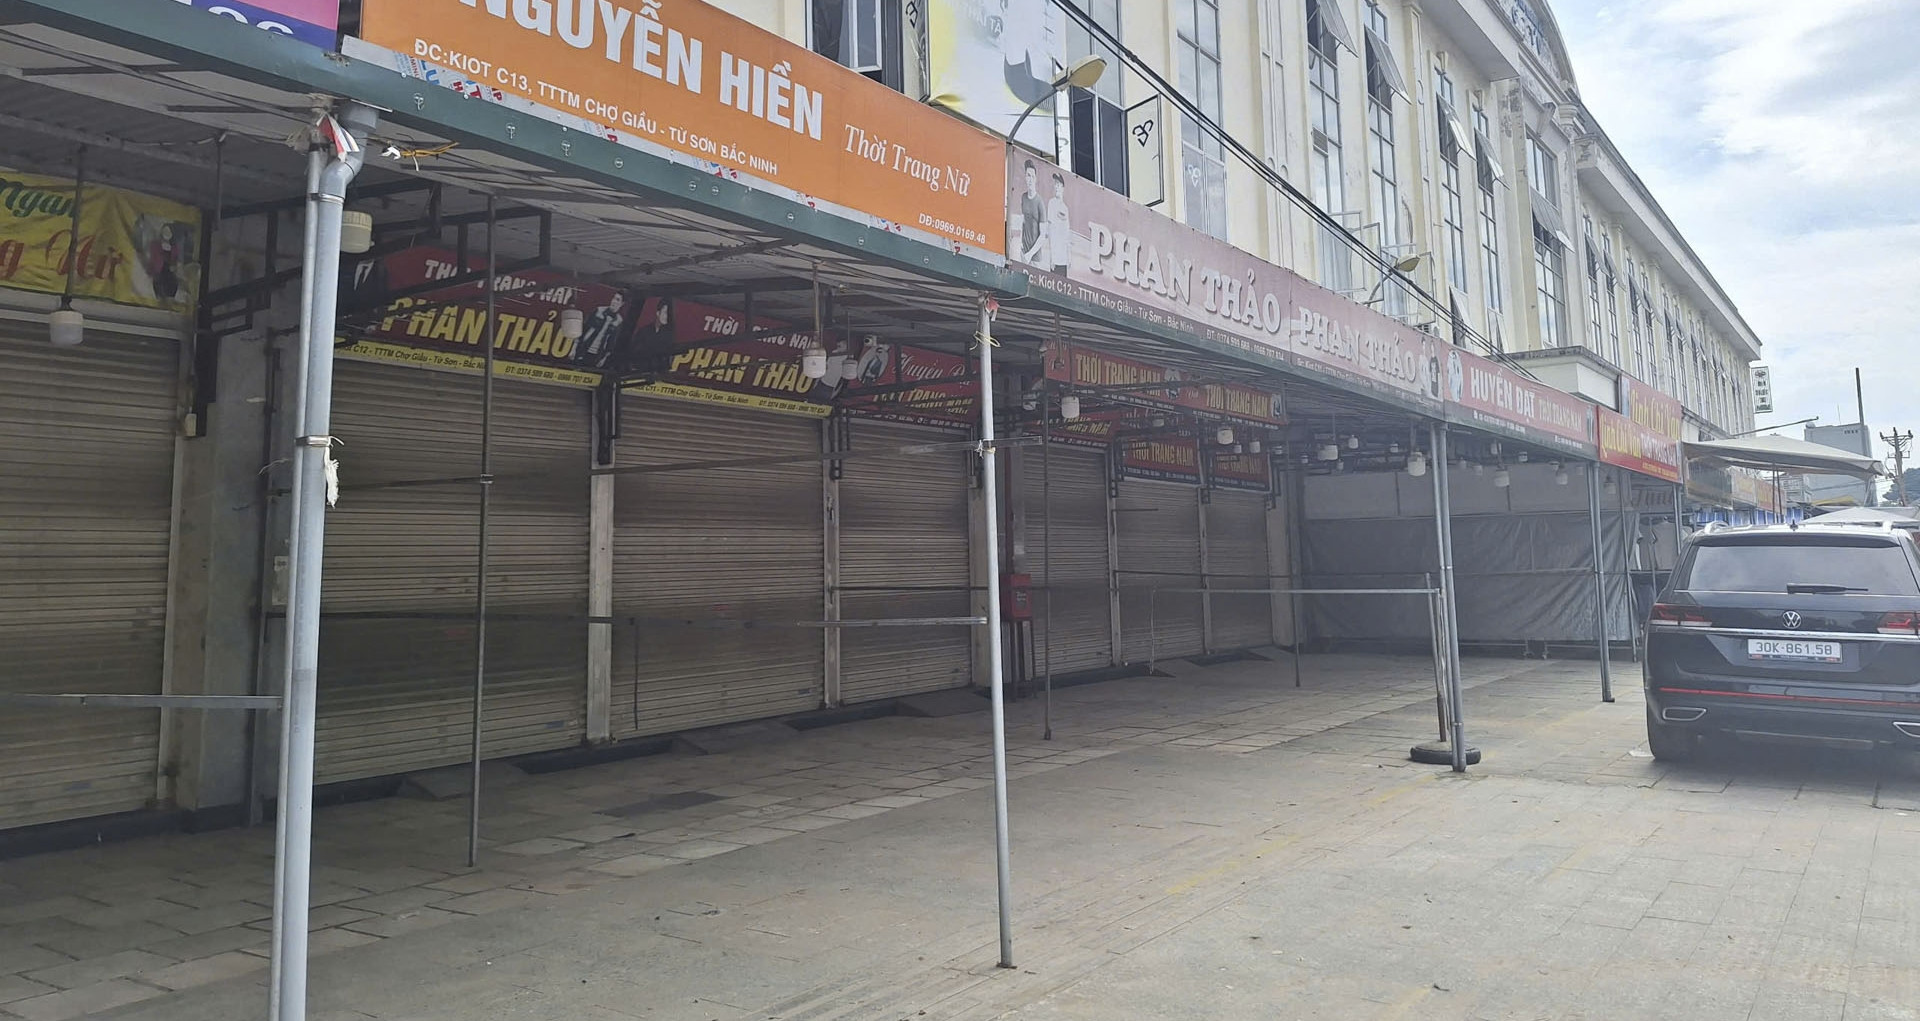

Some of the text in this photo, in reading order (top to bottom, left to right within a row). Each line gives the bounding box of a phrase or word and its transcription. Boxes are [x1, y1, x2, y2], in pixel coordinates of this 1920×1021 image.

[496, 67, 532, 95] C13,
[537, 81, 580, 108] TTTM
[584, 98, 619, 123] CHỢ
[622, 111, 657, 134] GIẦU
[668, 126, 688, 144] TỪ
[689, 134, 717, 155] SƠN
[720, 142, 746, 165] BẮC
[749, 155, 778, 176] NINH
[719, 51, 823, 141] HIỀN
[844, 123, 971, 197] Thời Trang Nữ
[1038, 274, 1055, 290] Kiot
[1057, 280, 1072, 296] C12
[1078, 286, 1099, 304] TTTM
[1087, 221, 1282, 334] PHAN THẢO
[704, 315, 739, 335] THỜI
[1298, 306, 1417, 384] PHAN THẢO
[1755, 642, 1832, 655] 30K-861.58
